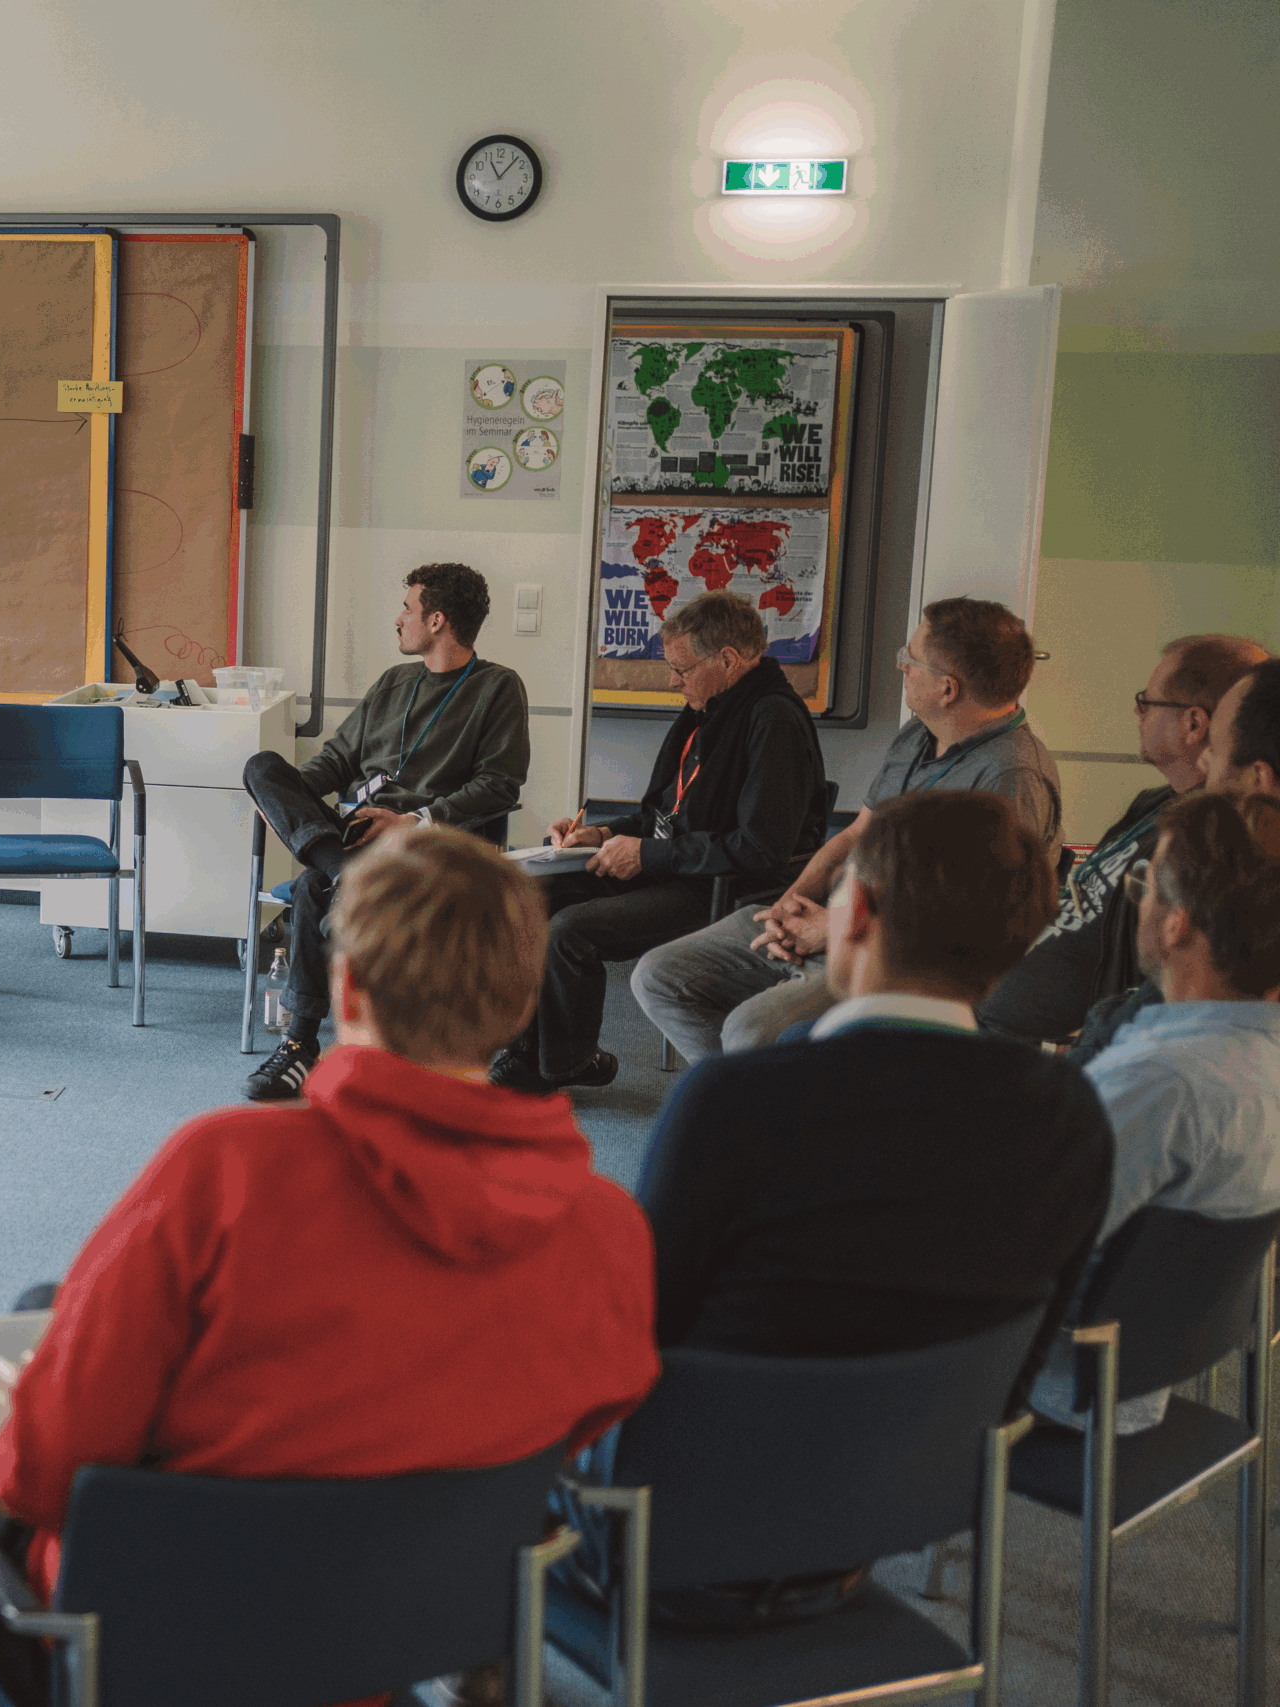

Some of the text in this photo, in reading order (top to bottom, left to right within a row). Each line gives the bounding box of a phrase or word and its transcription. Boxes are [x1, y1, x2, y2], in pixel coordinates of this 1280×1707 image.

[484, 151, 493, 162] 11
[496, 147, 505, 159] 12
[511, 151, 515, 161] 1
[475, 160, 484, 171] 10
[519, 160, 525, 170] 2
[522, 173, 529, 183] 3
[517, 185, 524, 196] 4
[485, 195, 491, 205] 7
[495, 199, 502, 209] 6
[508, 195, 515, 205] 5
[466, 415, 525, 427] Hygieneregeln
[466, 427, 512, 436] im Seminar
[780, 423, 823, 445] WE
[779, 445, 822, 463] WILL
[779, 463, 821, 483] RISE!
[604, 589, 649, 609] WE
[604, 609, 650, 627] WILL
[604, 627, 649, 646] BURN
